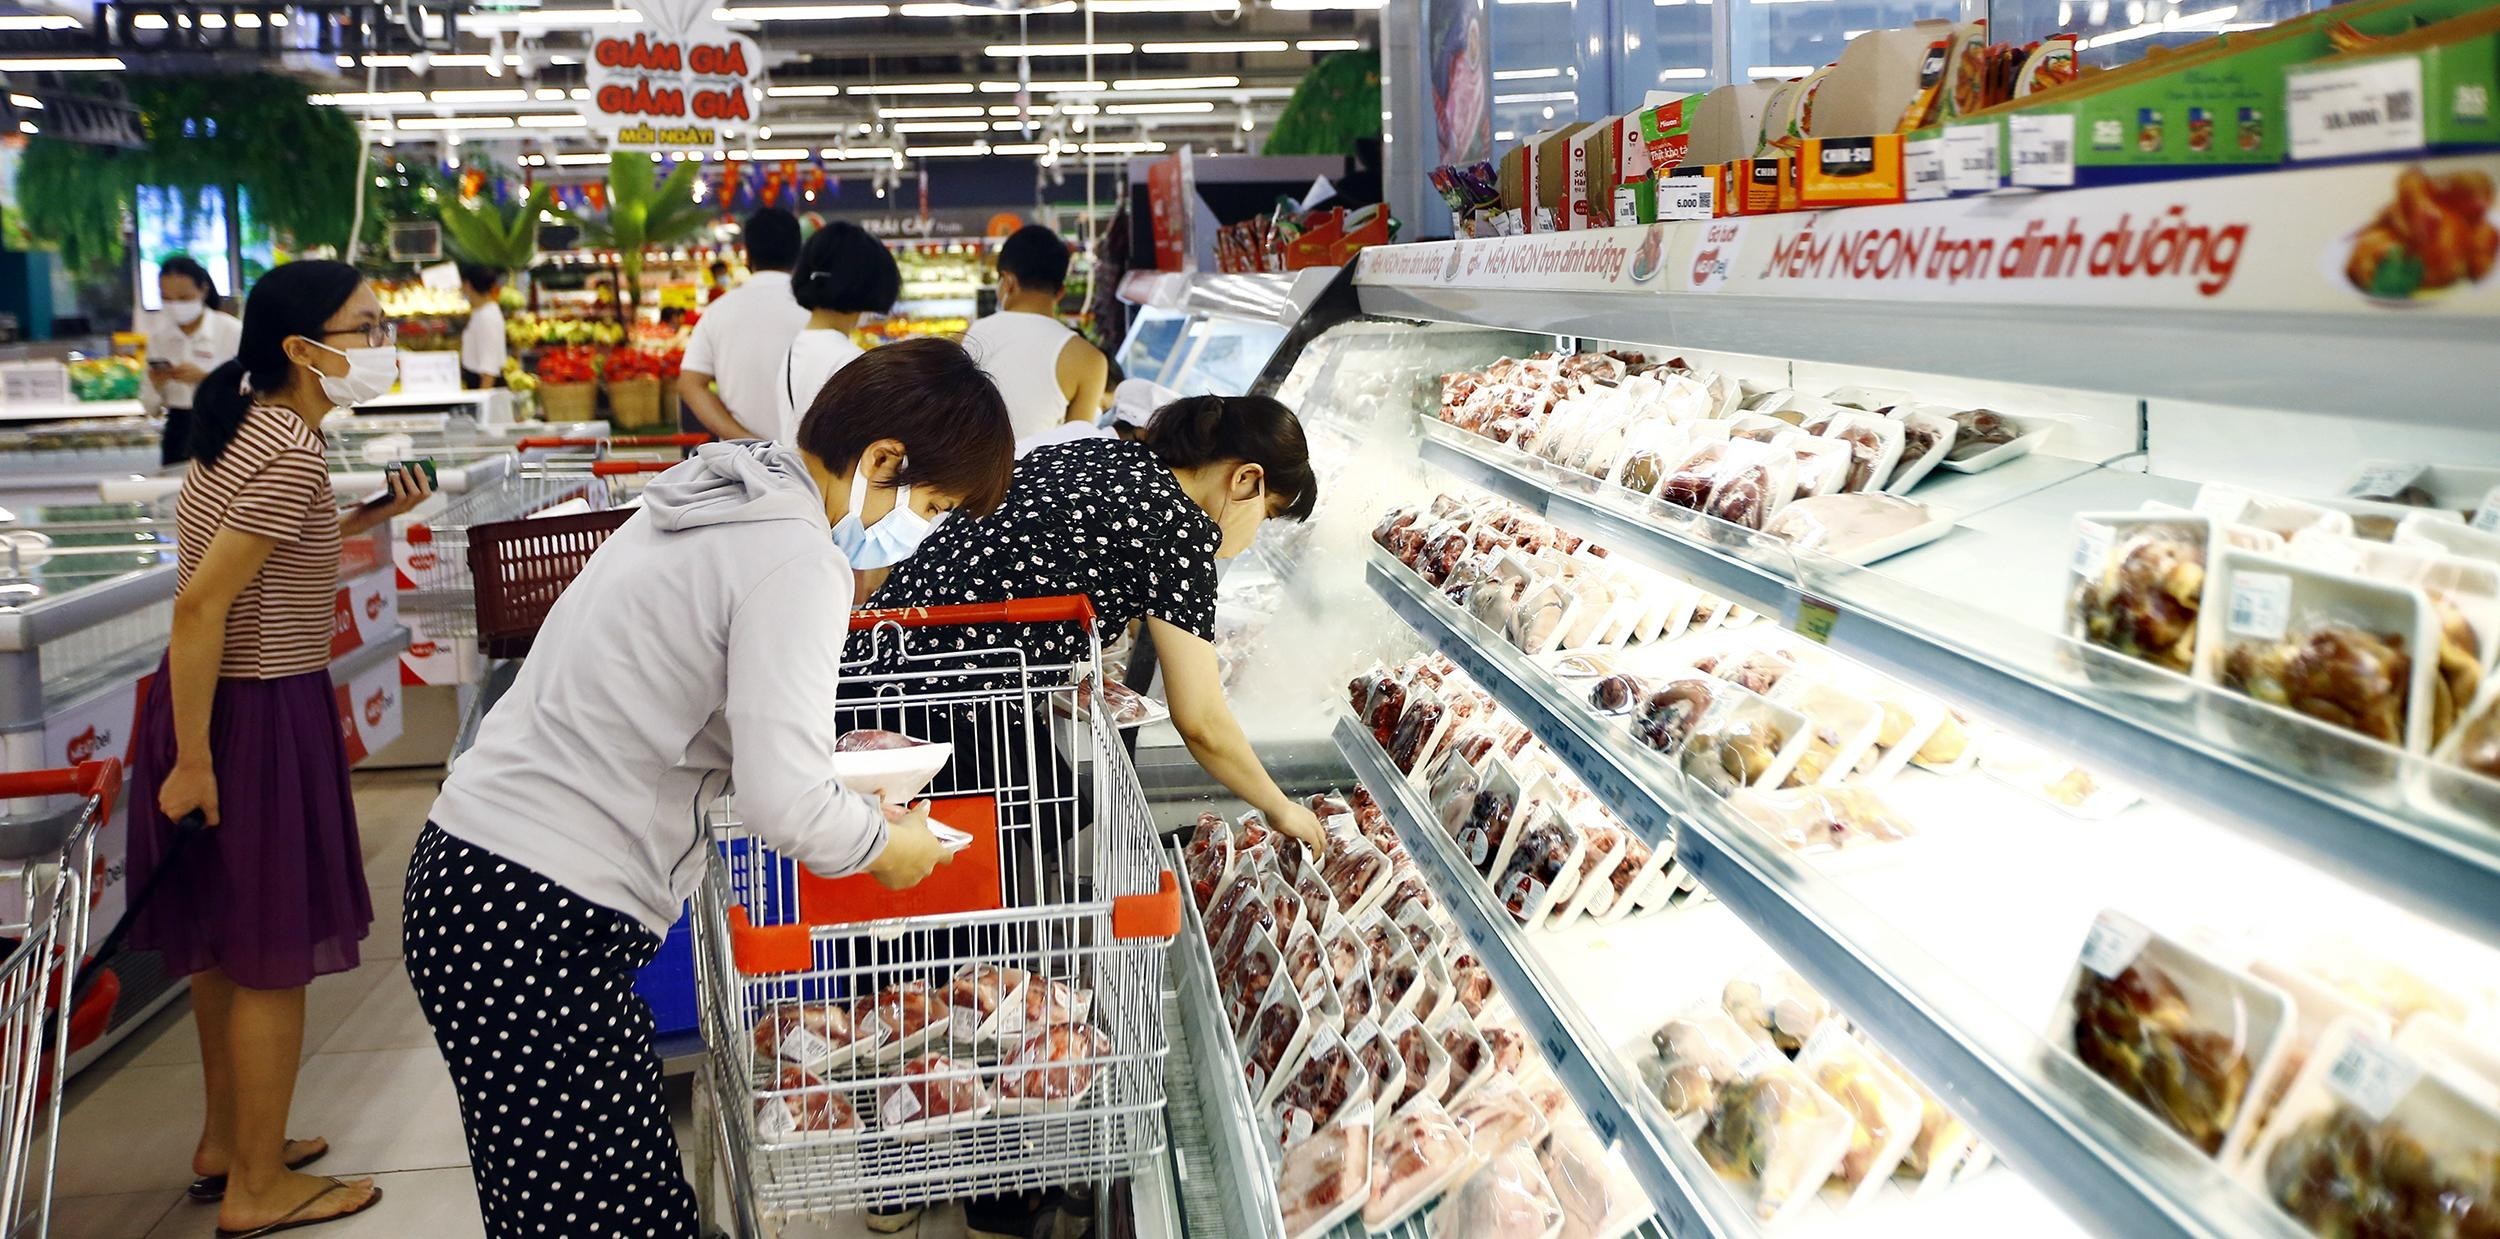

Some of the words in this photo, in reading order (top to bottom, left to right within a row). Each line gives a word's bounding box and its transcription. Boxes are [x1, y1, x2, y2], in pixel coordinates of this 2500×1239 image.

[595, 32, 682, 72] GIẢM
[689, 41, 748, 77] GIÁ
[597, 76, 685, 117] GIẢM
[692, 84, 749, 120] GIÁ
[1821, 147, 1872, 163] CHIN-SU
[1676, 199, 1698, 209] 6.000
[1828, 226, 1930, 280] NGON
[1926, 226, 1995, 285] trọn
[2087, 204, 2251, 297] dưỡng
